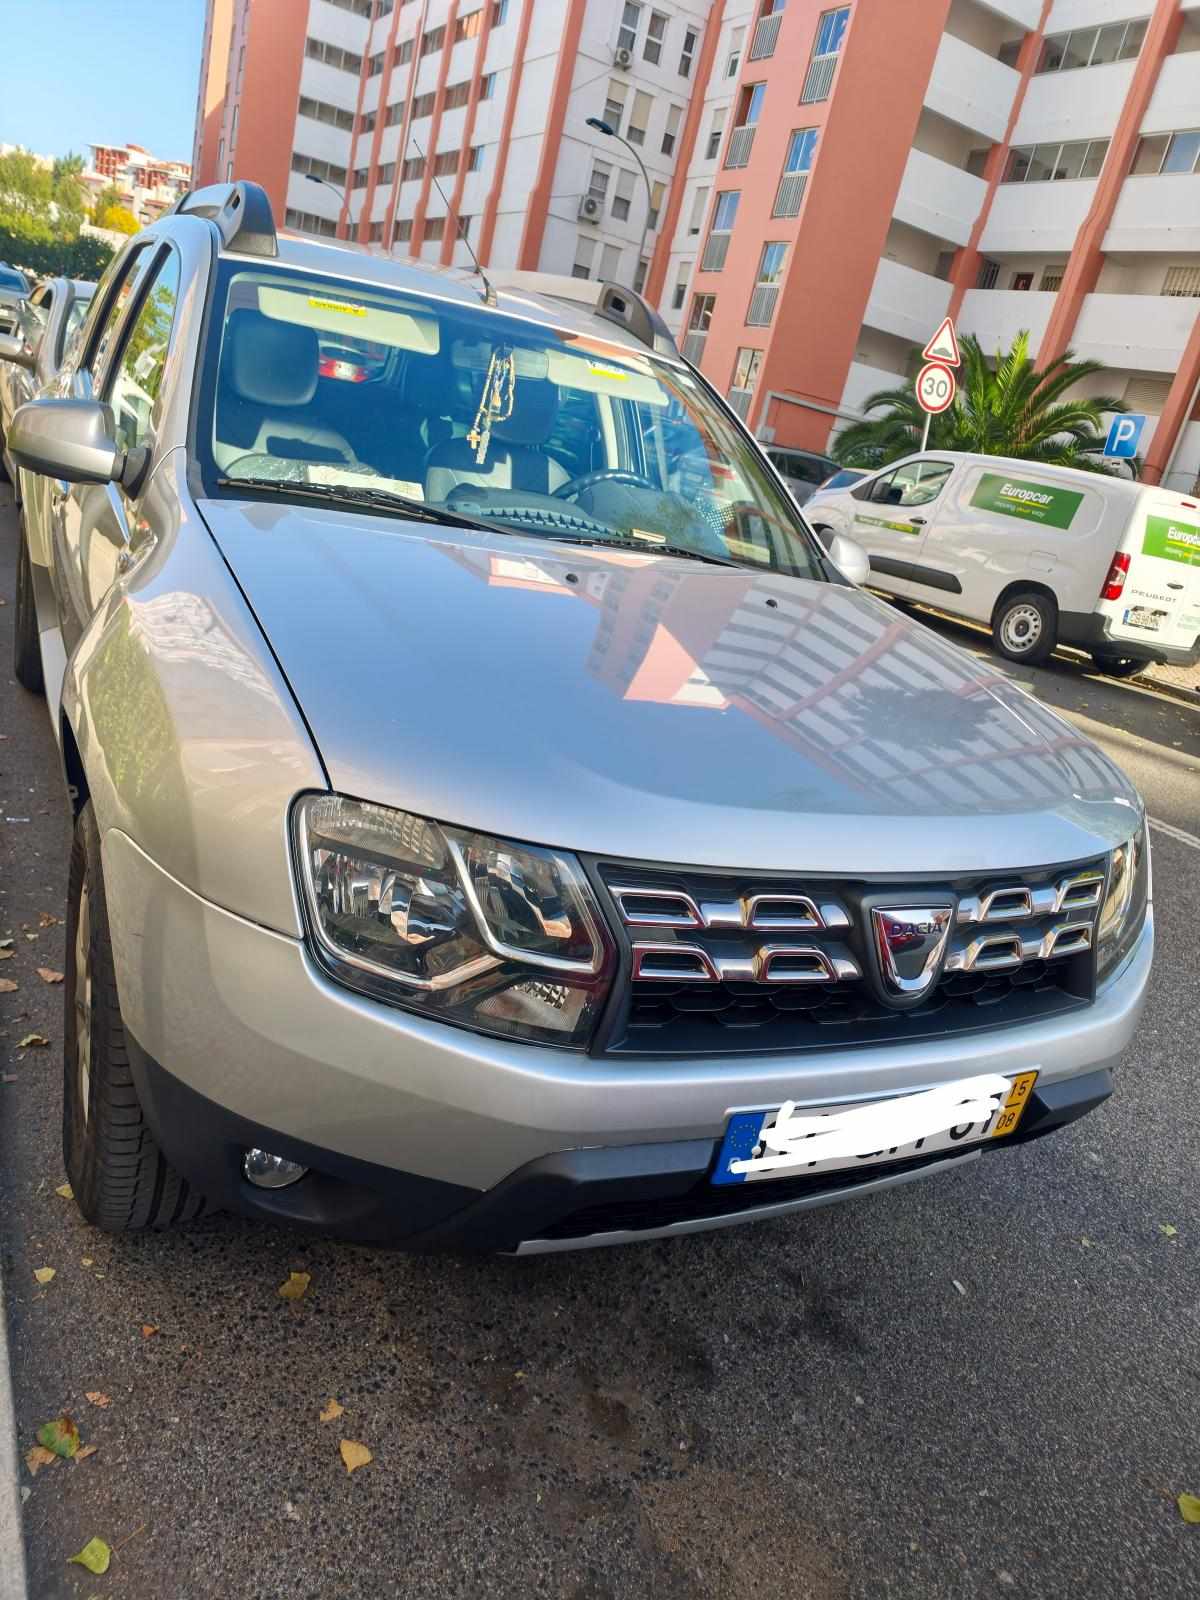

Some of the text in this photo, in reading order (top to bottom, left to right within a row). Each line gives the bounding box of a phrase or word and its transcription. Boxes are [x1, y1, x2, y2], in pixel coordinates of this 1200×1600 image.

[924, 376, 948, 398] 30
[1112, 419, 1135, 452] P
[999, 483, 1054, 504] Europcar
[892, 922, 942, 935] DACIA
[1009, 1079, 1030, 1097] 15
[996, 1112, 1016, 1130] 08
